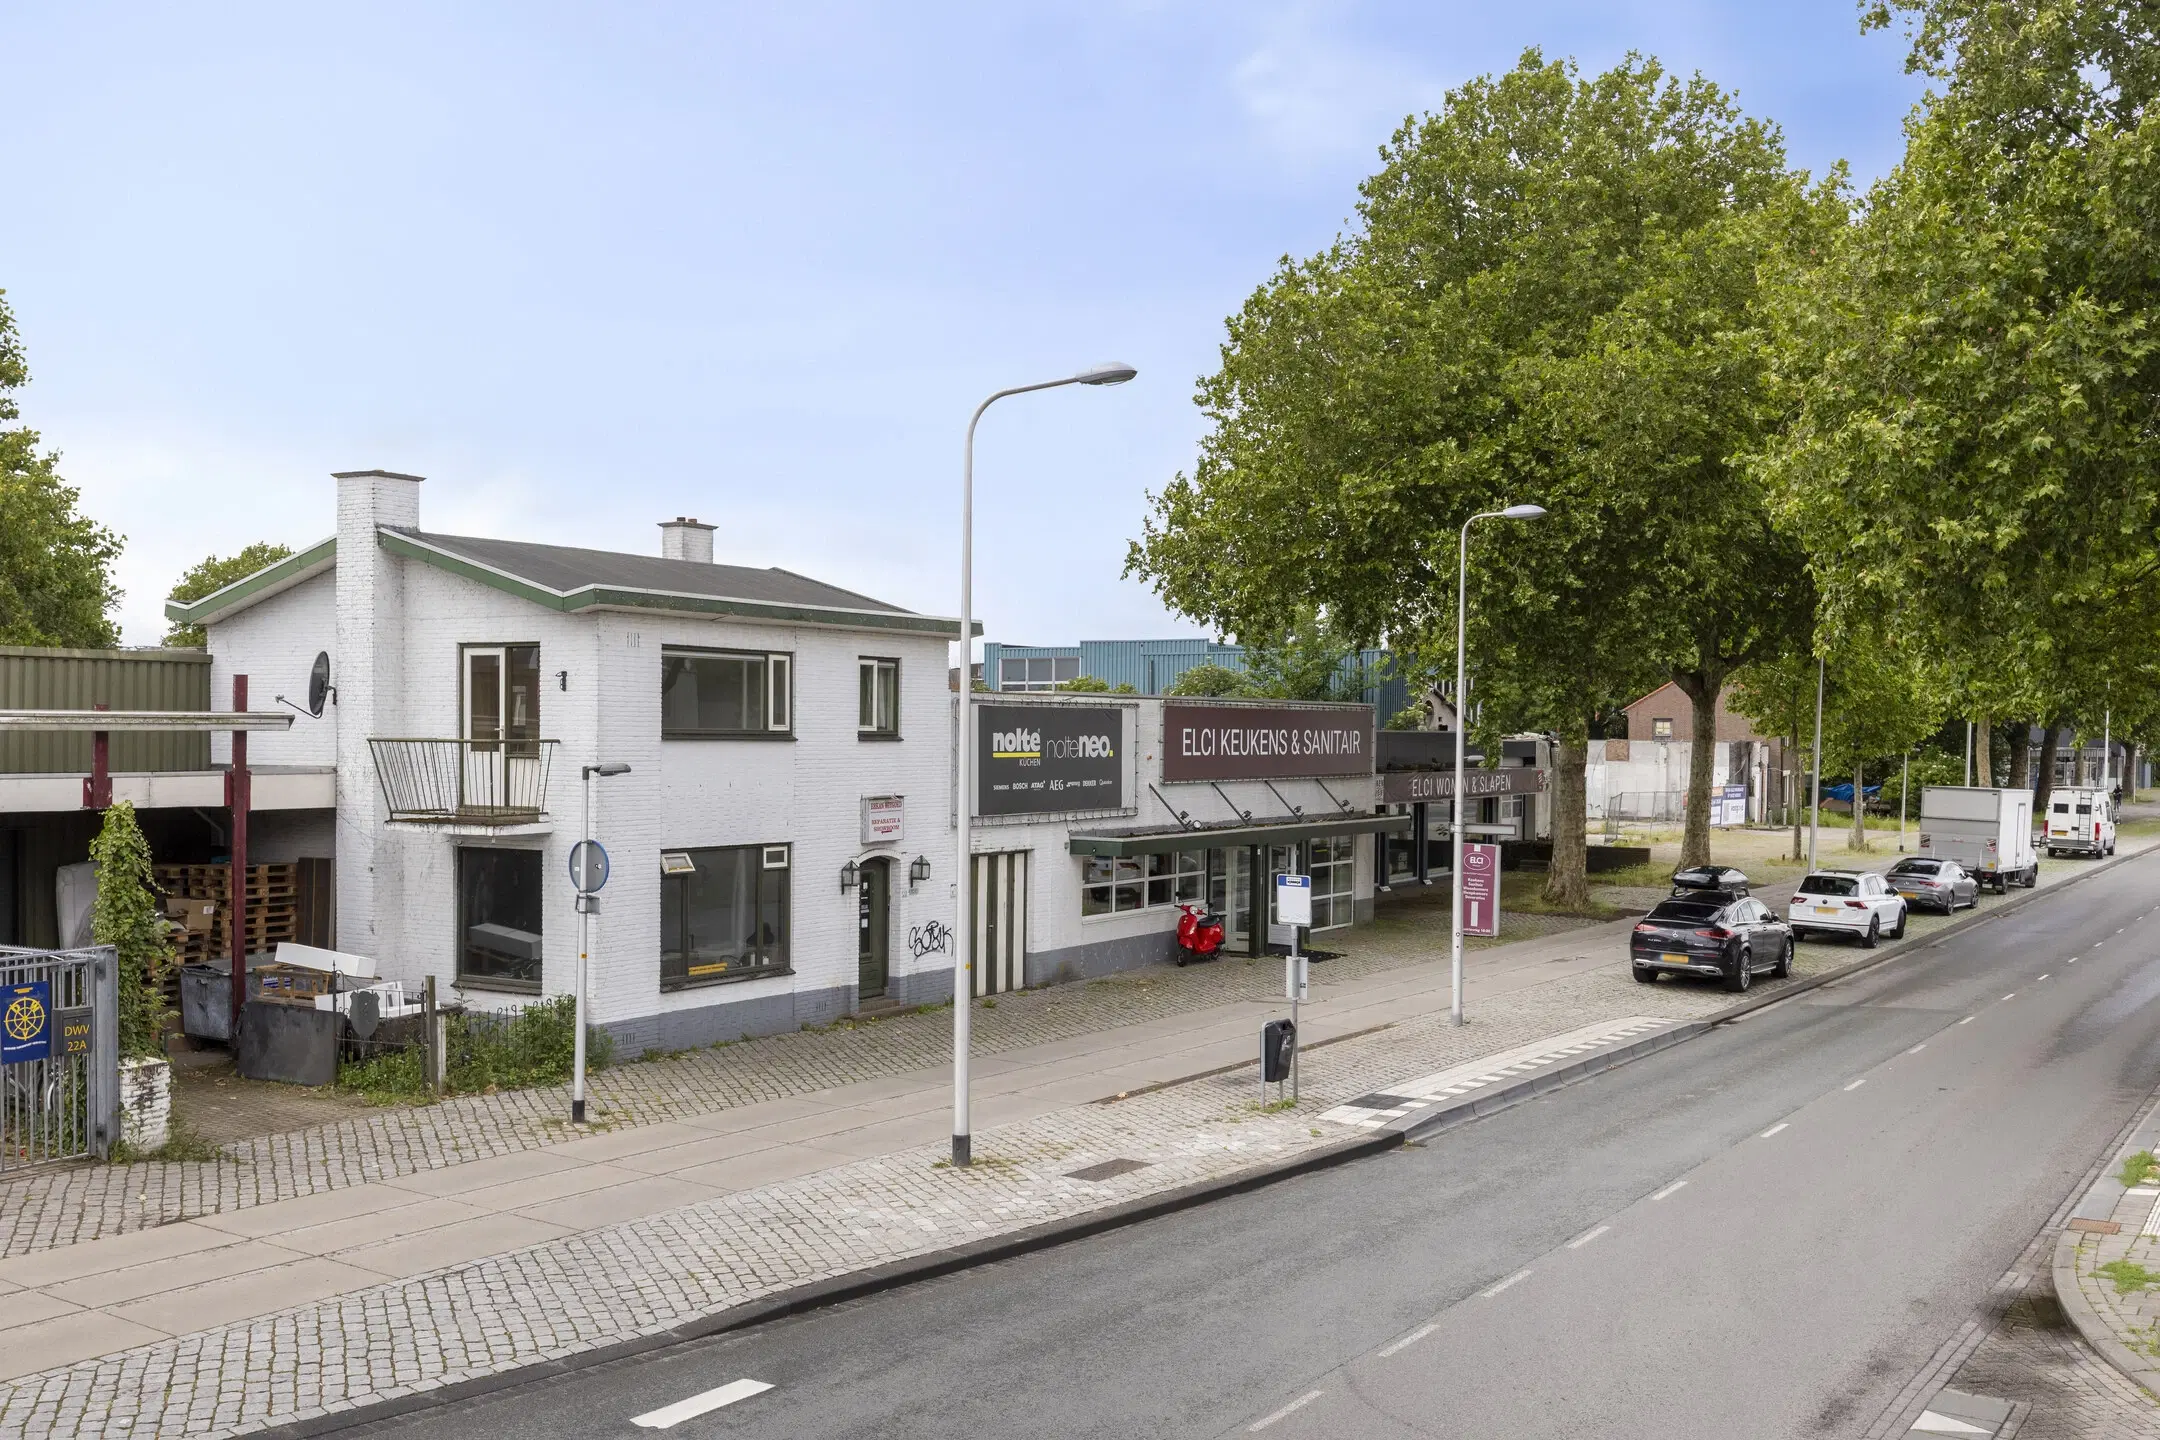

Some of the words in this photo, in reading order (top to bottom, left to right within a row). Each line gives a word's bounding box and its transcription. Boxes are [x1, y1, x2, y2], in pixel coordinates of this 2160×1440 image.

[993, 728, 1040, 752] nolte
[1182, 728, 1216, 756] ELCI
[1220, 728, 1288, 756] KEUKENS
[1291, 729, 1300, 755] &
[1303, 729, 1361, 755] SANITAIR
[1019, 757, 1040, 767] KÜCHEN
[1012, 782, 1029, 790] BOSCH
[1049, 779, 1064, 791] AEG
[1412, 778, 1433, 796] ELCI
[1436, 776, 1469, 796] WONN
[1471, 776, 1477, 793] &
[1479, 774, 1511, 793] SLAPEN
[64, 1024, 90, 1037] DWV
[67, 1040, 87, 1052] 22A
